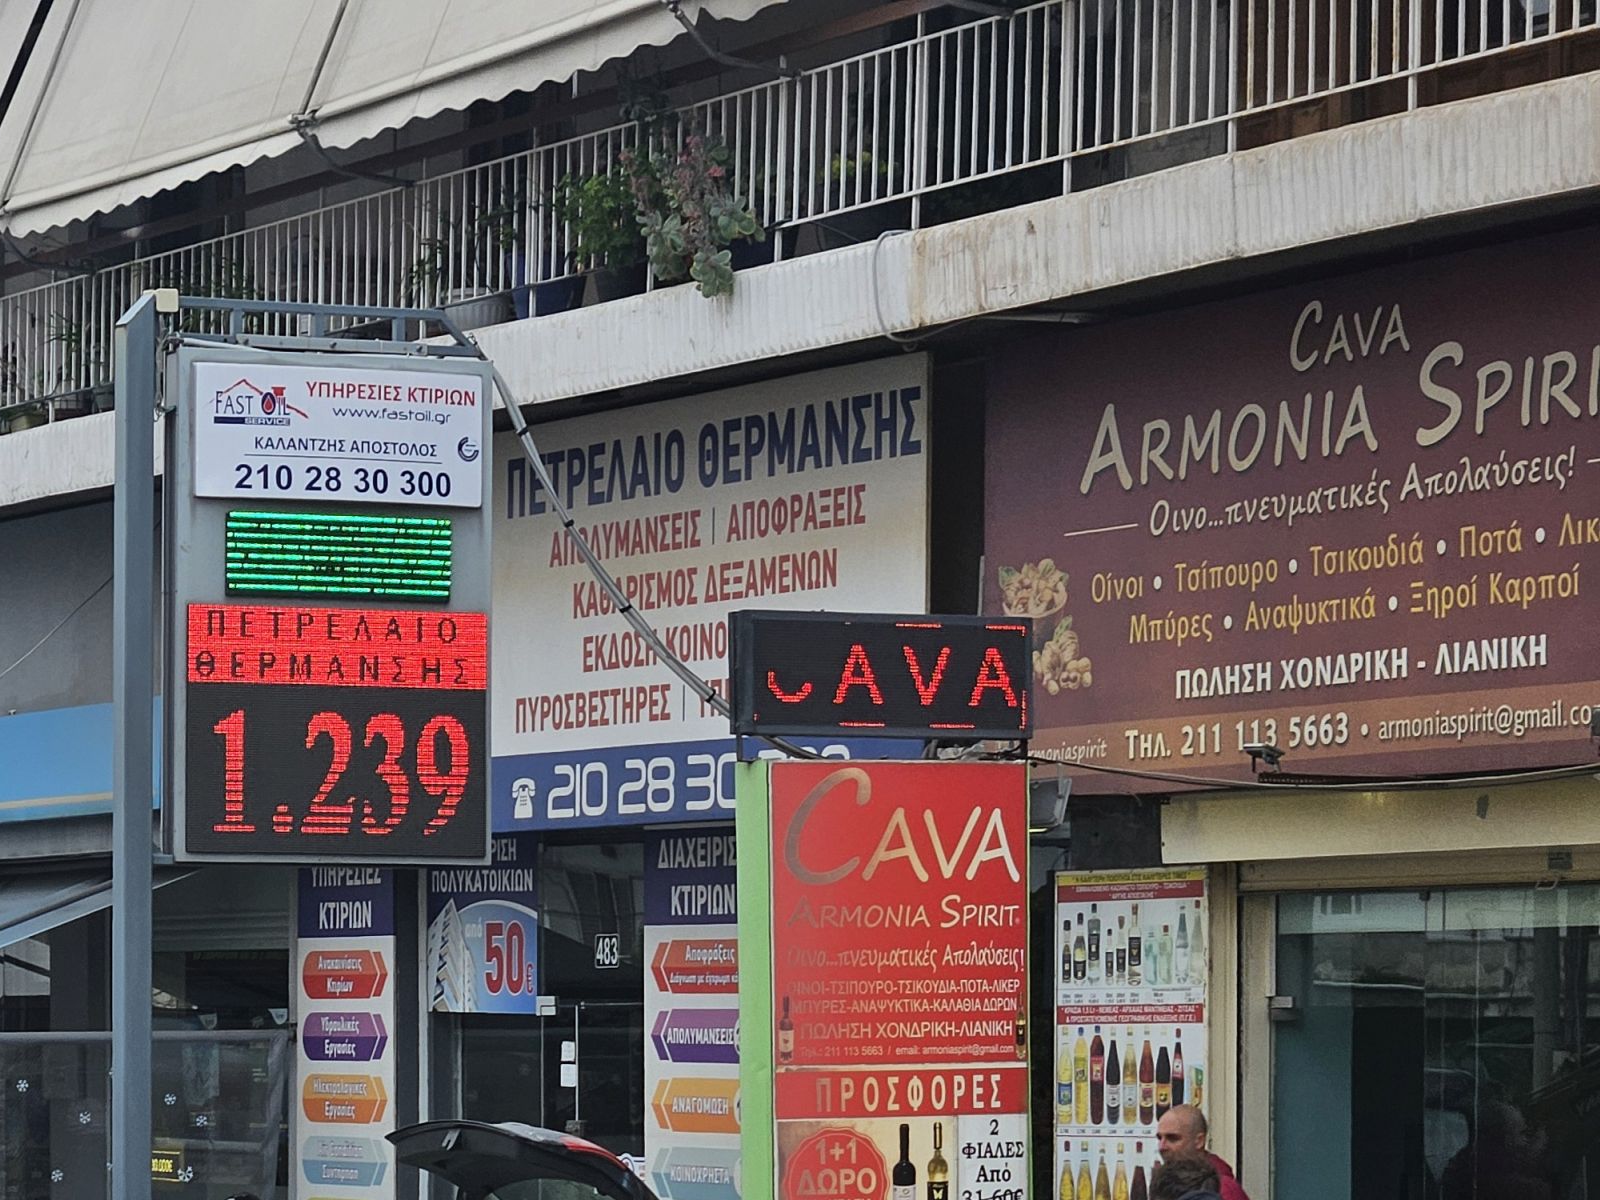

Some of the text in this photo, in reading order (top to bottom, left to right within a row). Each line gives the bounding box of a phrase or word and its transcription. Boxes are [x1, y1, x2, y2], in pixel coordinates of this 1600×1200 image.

[1290, 301, 1410, 372] CAVA
[215, 391, 291, 416] FAST OIL
[307, 381, 475, 406] ΥΠΗΡΕΣΙΕΣ ΚΤΙΡΙΩΝ
[244, 416, 291, 427] SERVICE
[332, 405, 451, 424] www.fastoil.gr
[1080, 341, 1600, 494] ARMONIA SPIRI
[254, 435, 437, 458] ΚΑΛΑΝΤΖΗΣ ΑΠΟΣΤΟΛΟΣ
[507, 387, 922, 519] ΠΕΤΡΕΛΑΙΟ ΘΕΡΜΑΝΣΗΣ
[235, 464, 451, 497] 210 28 30 300
[1150, 446, 1575, 536] Οινο...πνευματικές Απολαύσεις!
[550, 484, 866, 568] ΑΠΟΛΥΜΑΝΣΕΙΣ ΑΠΟΦΡΑΞΕΙΣ
[1091, 512, 1600, 604] Οίνοι Τσίπουρο Τσικουδιά Ποτά Λικ
[573, 548, 838, 619] ΚΑΘΑΡΙΣΜΟΣ ΔΕΞΑΜΕΝΩΝ
[1129, 564, 1580, 647] Μπύρες Αναψυκτικά Ξηροί Καρποί
[207, 609, 457, 644] ΠΕΤΡΕΛΑΙΟ
[583, 621, 727, 672] ΕΚΔΟΣΗ ΚΟΙΝΟ
[195, 650, 469, 685] ΘΕΡΜΑΝΣΗΣ
[1176, 634, 1548, 699] ΠΩΛΗΣΗ ΧΟΝΔΡΙΚΗ ΛΙΑΝΙΚΗ
[515, 684, 671, 734] ΠΥΡΟΣΒΕΣΤΗΡΕΣ
[1378, 699, 1595, 741] armoniaspirit@gmail.co
[1027, 738, 1107, 763] rmoniaspirit
[1181, 722, 1221, 756] 211
[1236, 717, 1278, 749] 113
[1289, 712, 1349, 748] 5663
[213, 709, 470, 835] 1.239
[547, 761, 608, 819] 210
[618, 756, 675, 815] 28
[784, 767, 1020, 885] CAVA
[658, 837, 737, 869] ΔΙΑΧΕΙΡΙΣ
[432, 868, 533, 893] ΠΟΛΥΚΑΤΟΙΚΙΩΝ
[319, 901, 371, 930] ΚΤΙΡΙΩΝ
[671, 883, 736, 916] ΚΤΙΡΙΩΝ
[787, 895, 1020, 929] ARMONIA SPIRIT
[596, 938, 618, 965] 483
[685, 945, 735, 965] Αποφράξεις
[942, 940, 1025, 973] Απολαύσεις!
[666, 1028, 735, 1046] ΑΠΟΛΥΜΑΝΣΕΙΣ
[801, 1023, 871, 1040] ΠΩΛΗΣΗ
[672, 1096, 729, 1114] ΑΝΑΓΟΜΩΣΗ
[815, 1074, 1001, 1113] ΠΡΟΣΦΟΡΕΣ
[989, 1119, 999, 1136] 2
[816, 1136, 856, 1165] 1+1
[962, 1141, 1024, 1159] ΦΙΑΛΕΣ
[671, 1166, 730, 1184] ΚΟΙΝΟΧΡΗΣΤΑ
[797, 1167, 877, 1196] ΔΩΡΟ
[976, 1162, 1011, 1183] Από
